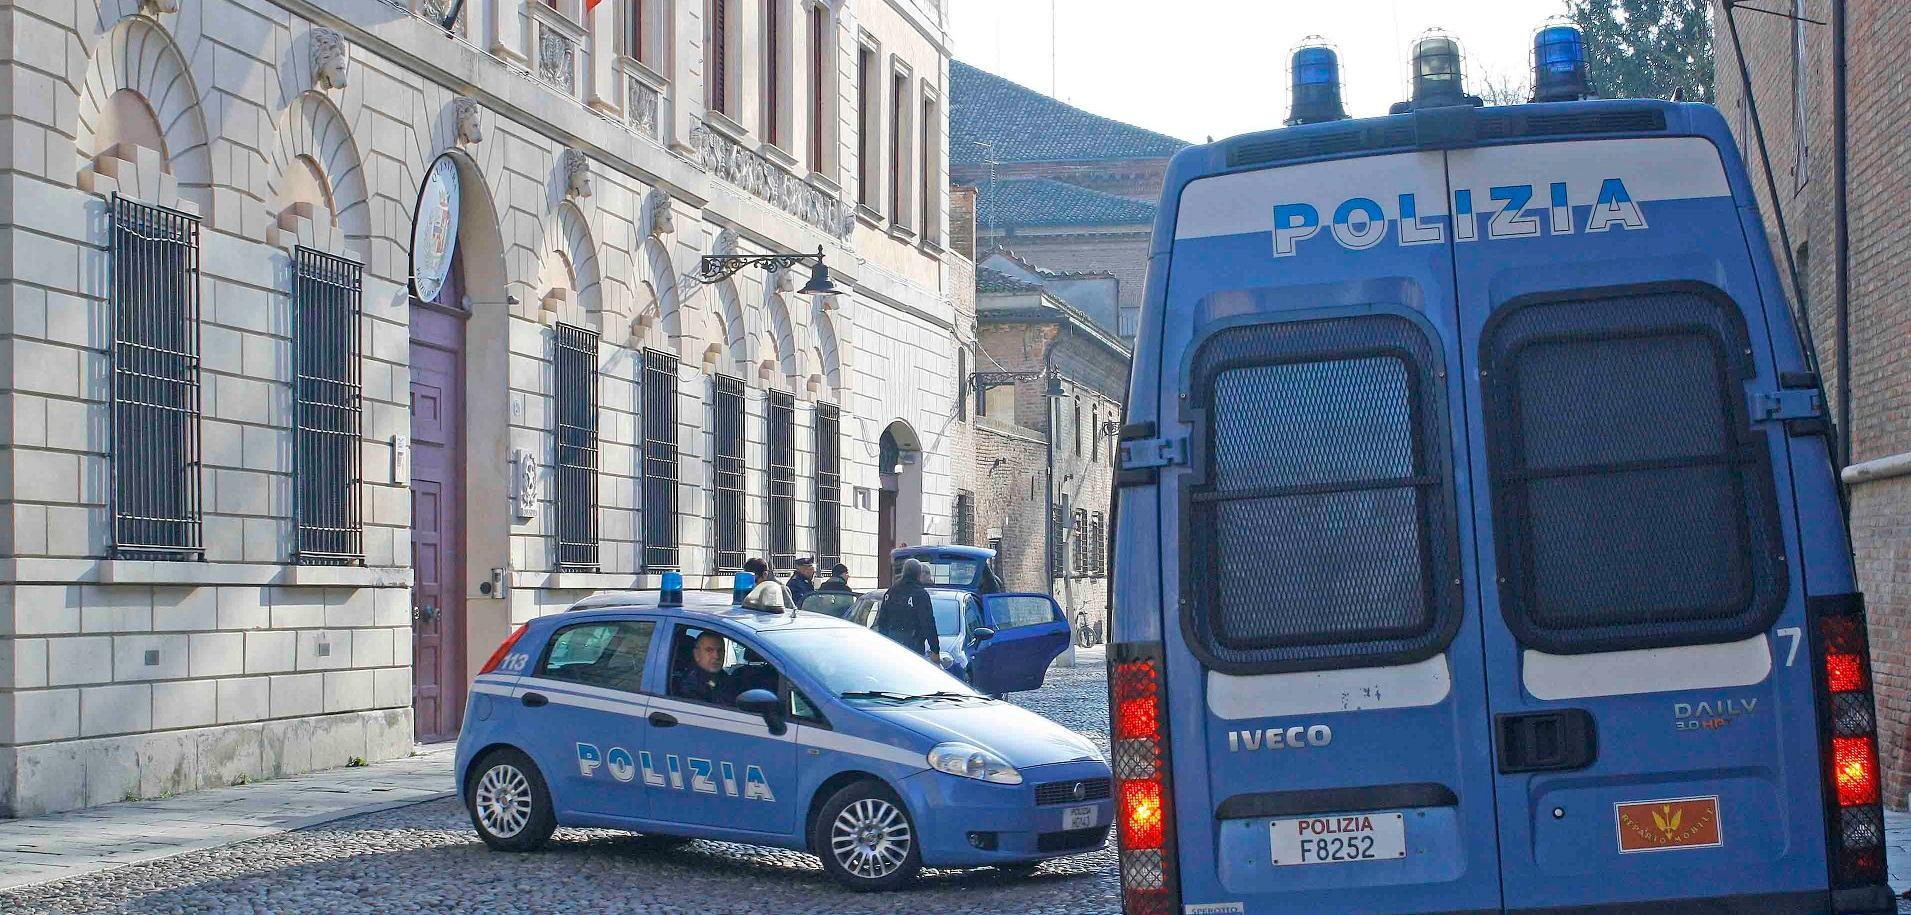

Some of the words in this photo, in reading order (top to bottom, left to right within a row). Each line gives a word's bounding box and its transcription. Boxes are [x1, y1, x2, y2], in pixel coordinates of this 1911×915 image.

[1272, 177, 1648, 258] POLIZIA
[1776, 627, 1801, 667] 7
[501, 653, 529, 671] 113
[1674, 697, 1759, 719] DAILY
[1228, 724, 1332, 752] IVECO
[576, 741, 776, 803] POLIZIA
[1298, 816, 1374, 836] POLIZIA
[1621, 813, 1666, 844] REPARTO
[1674, 807, 1714, 844] MOBILE
[1300, 835, 1376, 863] F8252
